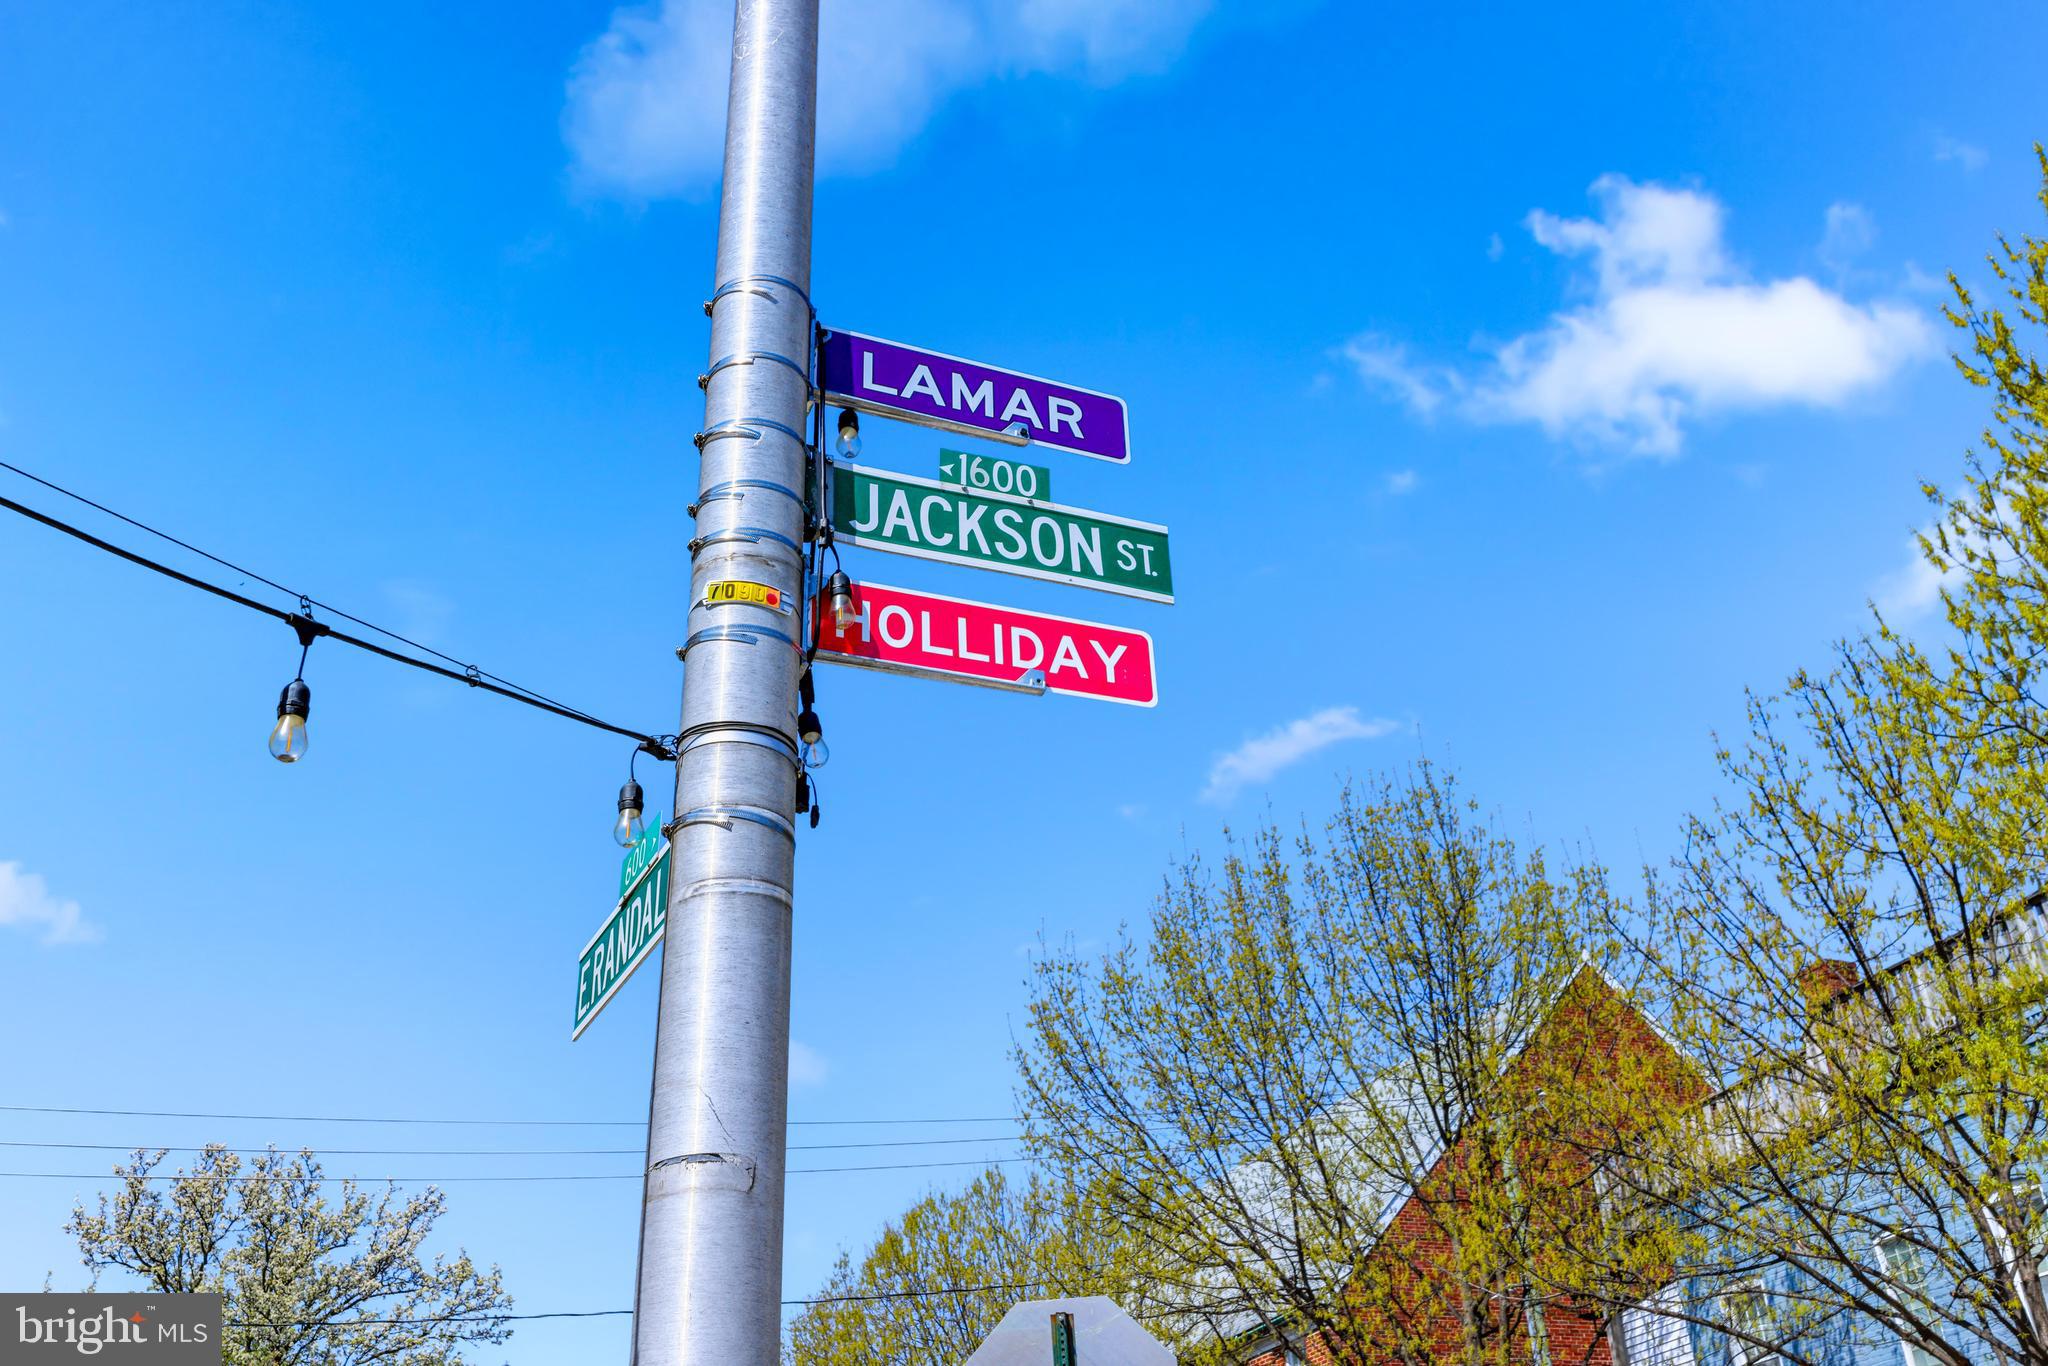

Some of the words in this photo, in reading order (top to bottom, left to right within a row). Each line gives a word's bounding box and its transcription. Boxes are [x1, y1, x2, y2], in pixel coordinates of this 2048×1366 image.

[862, 350, 1085, 440] LAMAR
[958, 453, 1037, 497] 1600
[849, 483, 1104, 576] JACKSON
[1116, 539, 1159, 577] ST.
[835, 599, 1128, 684] HOLLIDAY
[625, 838, 647, 886] 600
